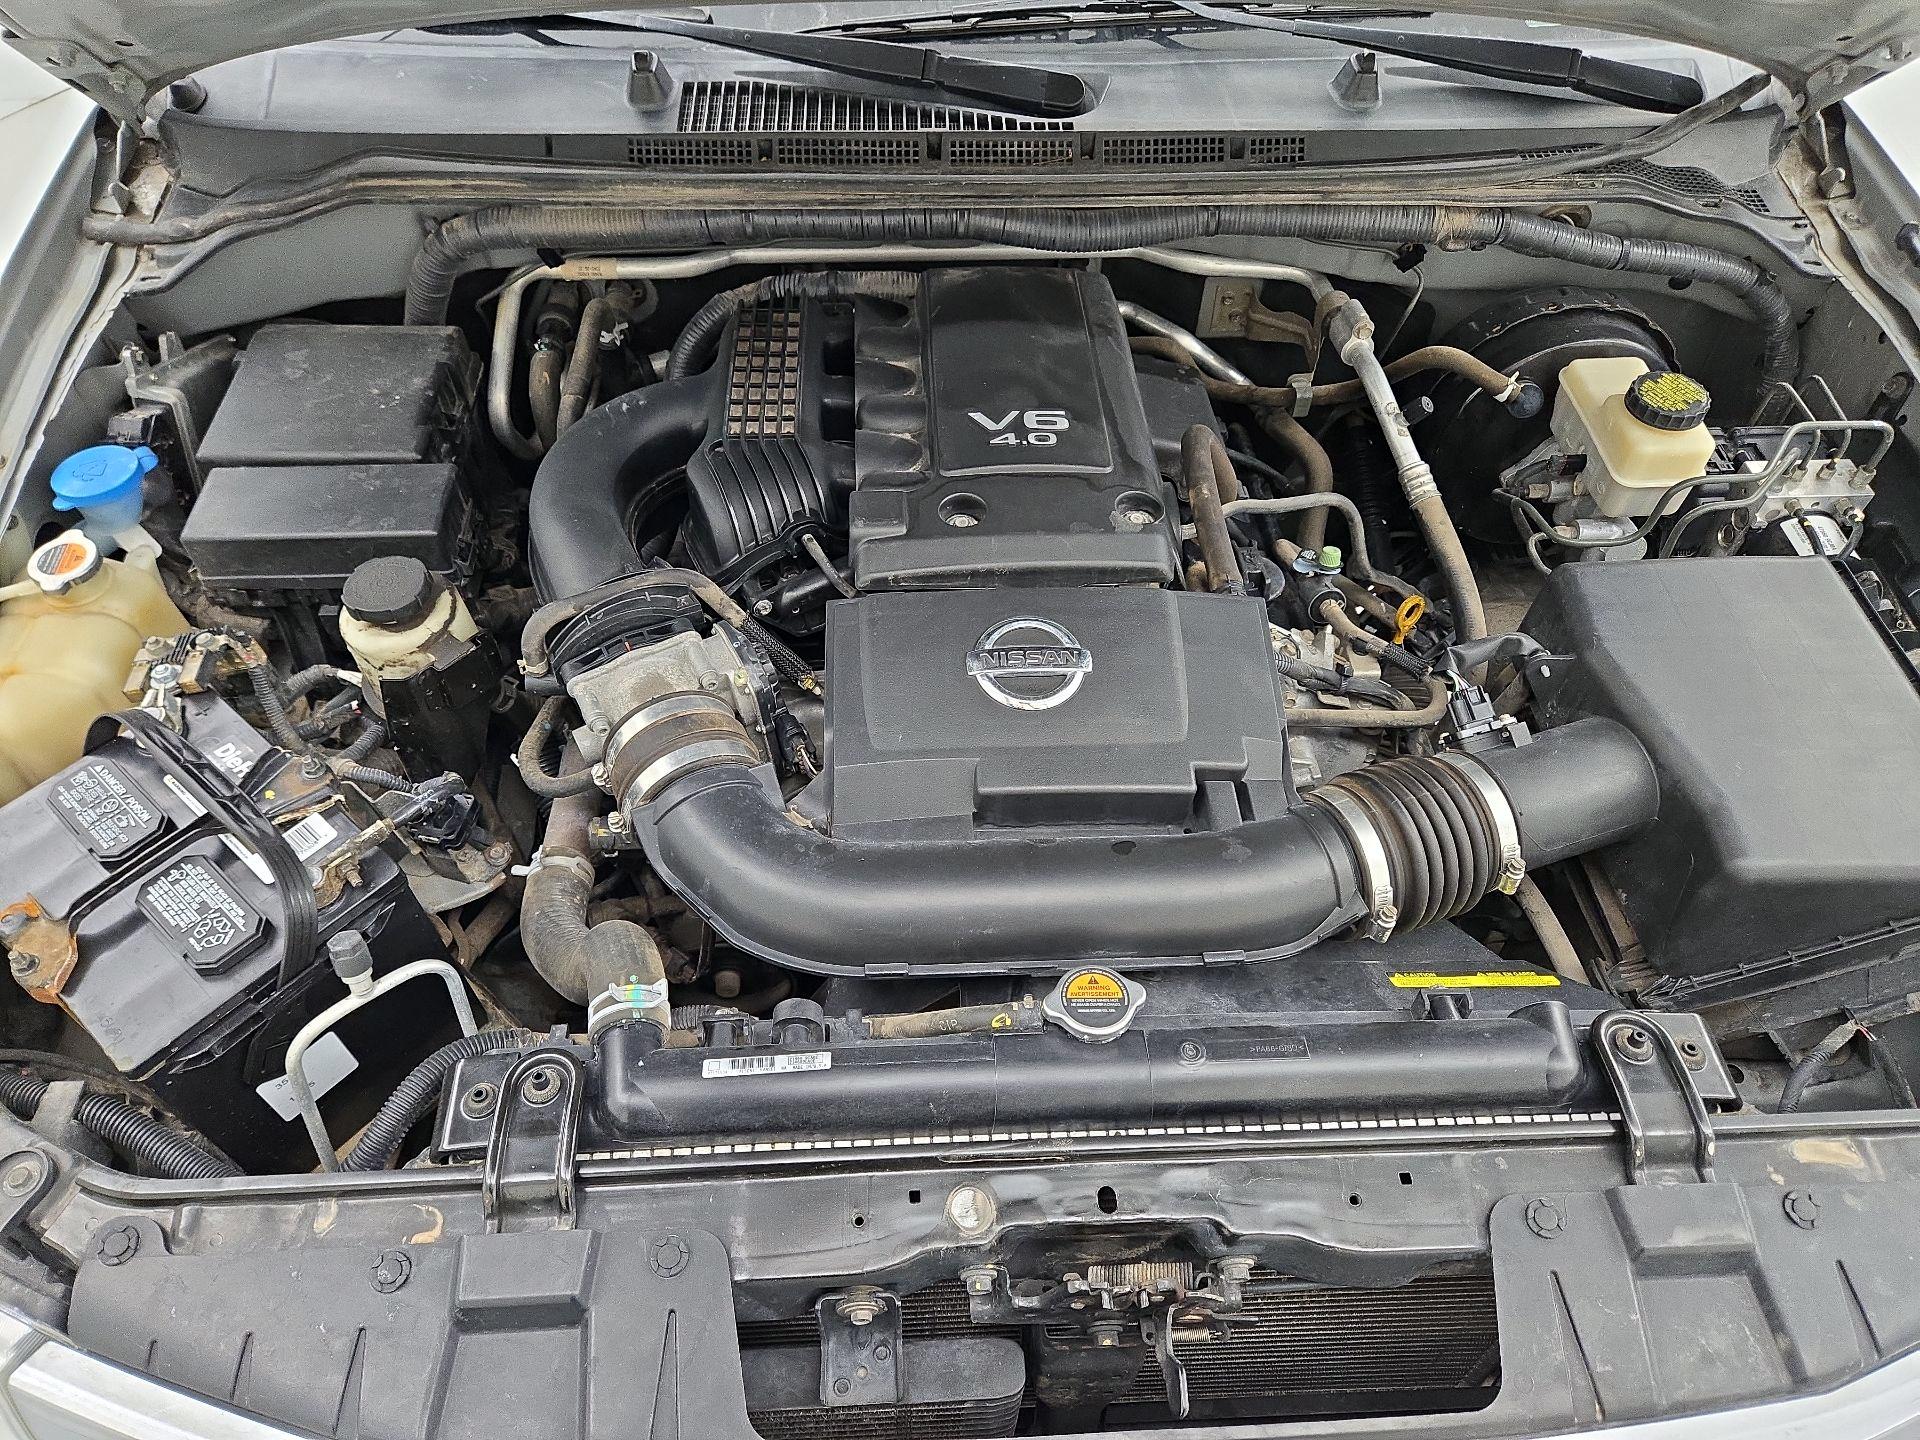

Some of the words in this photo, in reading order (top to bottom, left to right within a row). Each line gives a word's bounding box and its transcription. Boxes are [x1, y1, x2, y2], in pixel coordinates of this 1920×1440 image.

[968, 410, 1070, 431] V6
[989, 432, 1057, 447] 4.0
[980, 651, 1079, 667] NISSAN
[99, 768, 127, 795] DANGER
[125, 796, 151, 821] POISON
